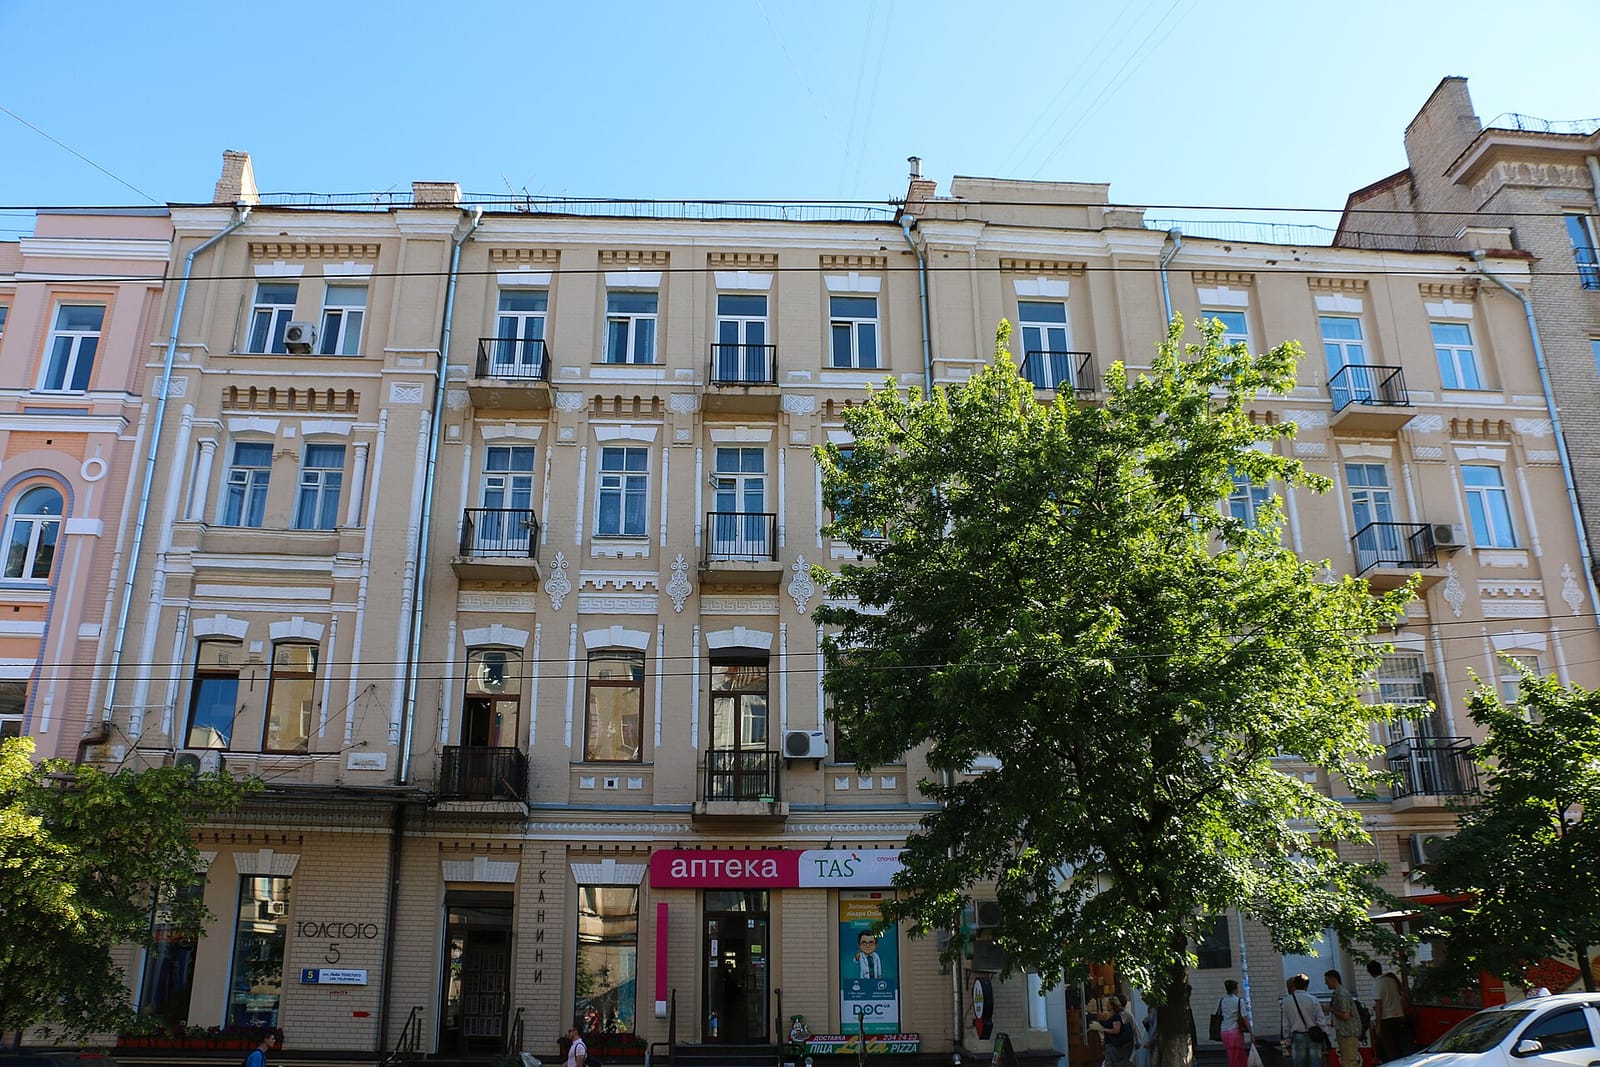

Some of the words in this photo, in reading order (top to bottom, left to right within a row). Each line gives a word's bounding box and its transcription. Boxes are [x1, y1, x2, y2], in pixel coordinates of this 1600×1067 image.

[670, 858, 778, 878] аптека
[814, 859, 854, 878] TAS
[534, 850, 547, 983] ТКАНИНИ
[296, 922, 378, 939] ТОЛСТОГО
[325, 943, 340, 964] 5
[307, 970, 314, 979] 5
[809, 1044, 832, 1054] ПІЦА
[890, 1044, 917, 1053] PIZZA
